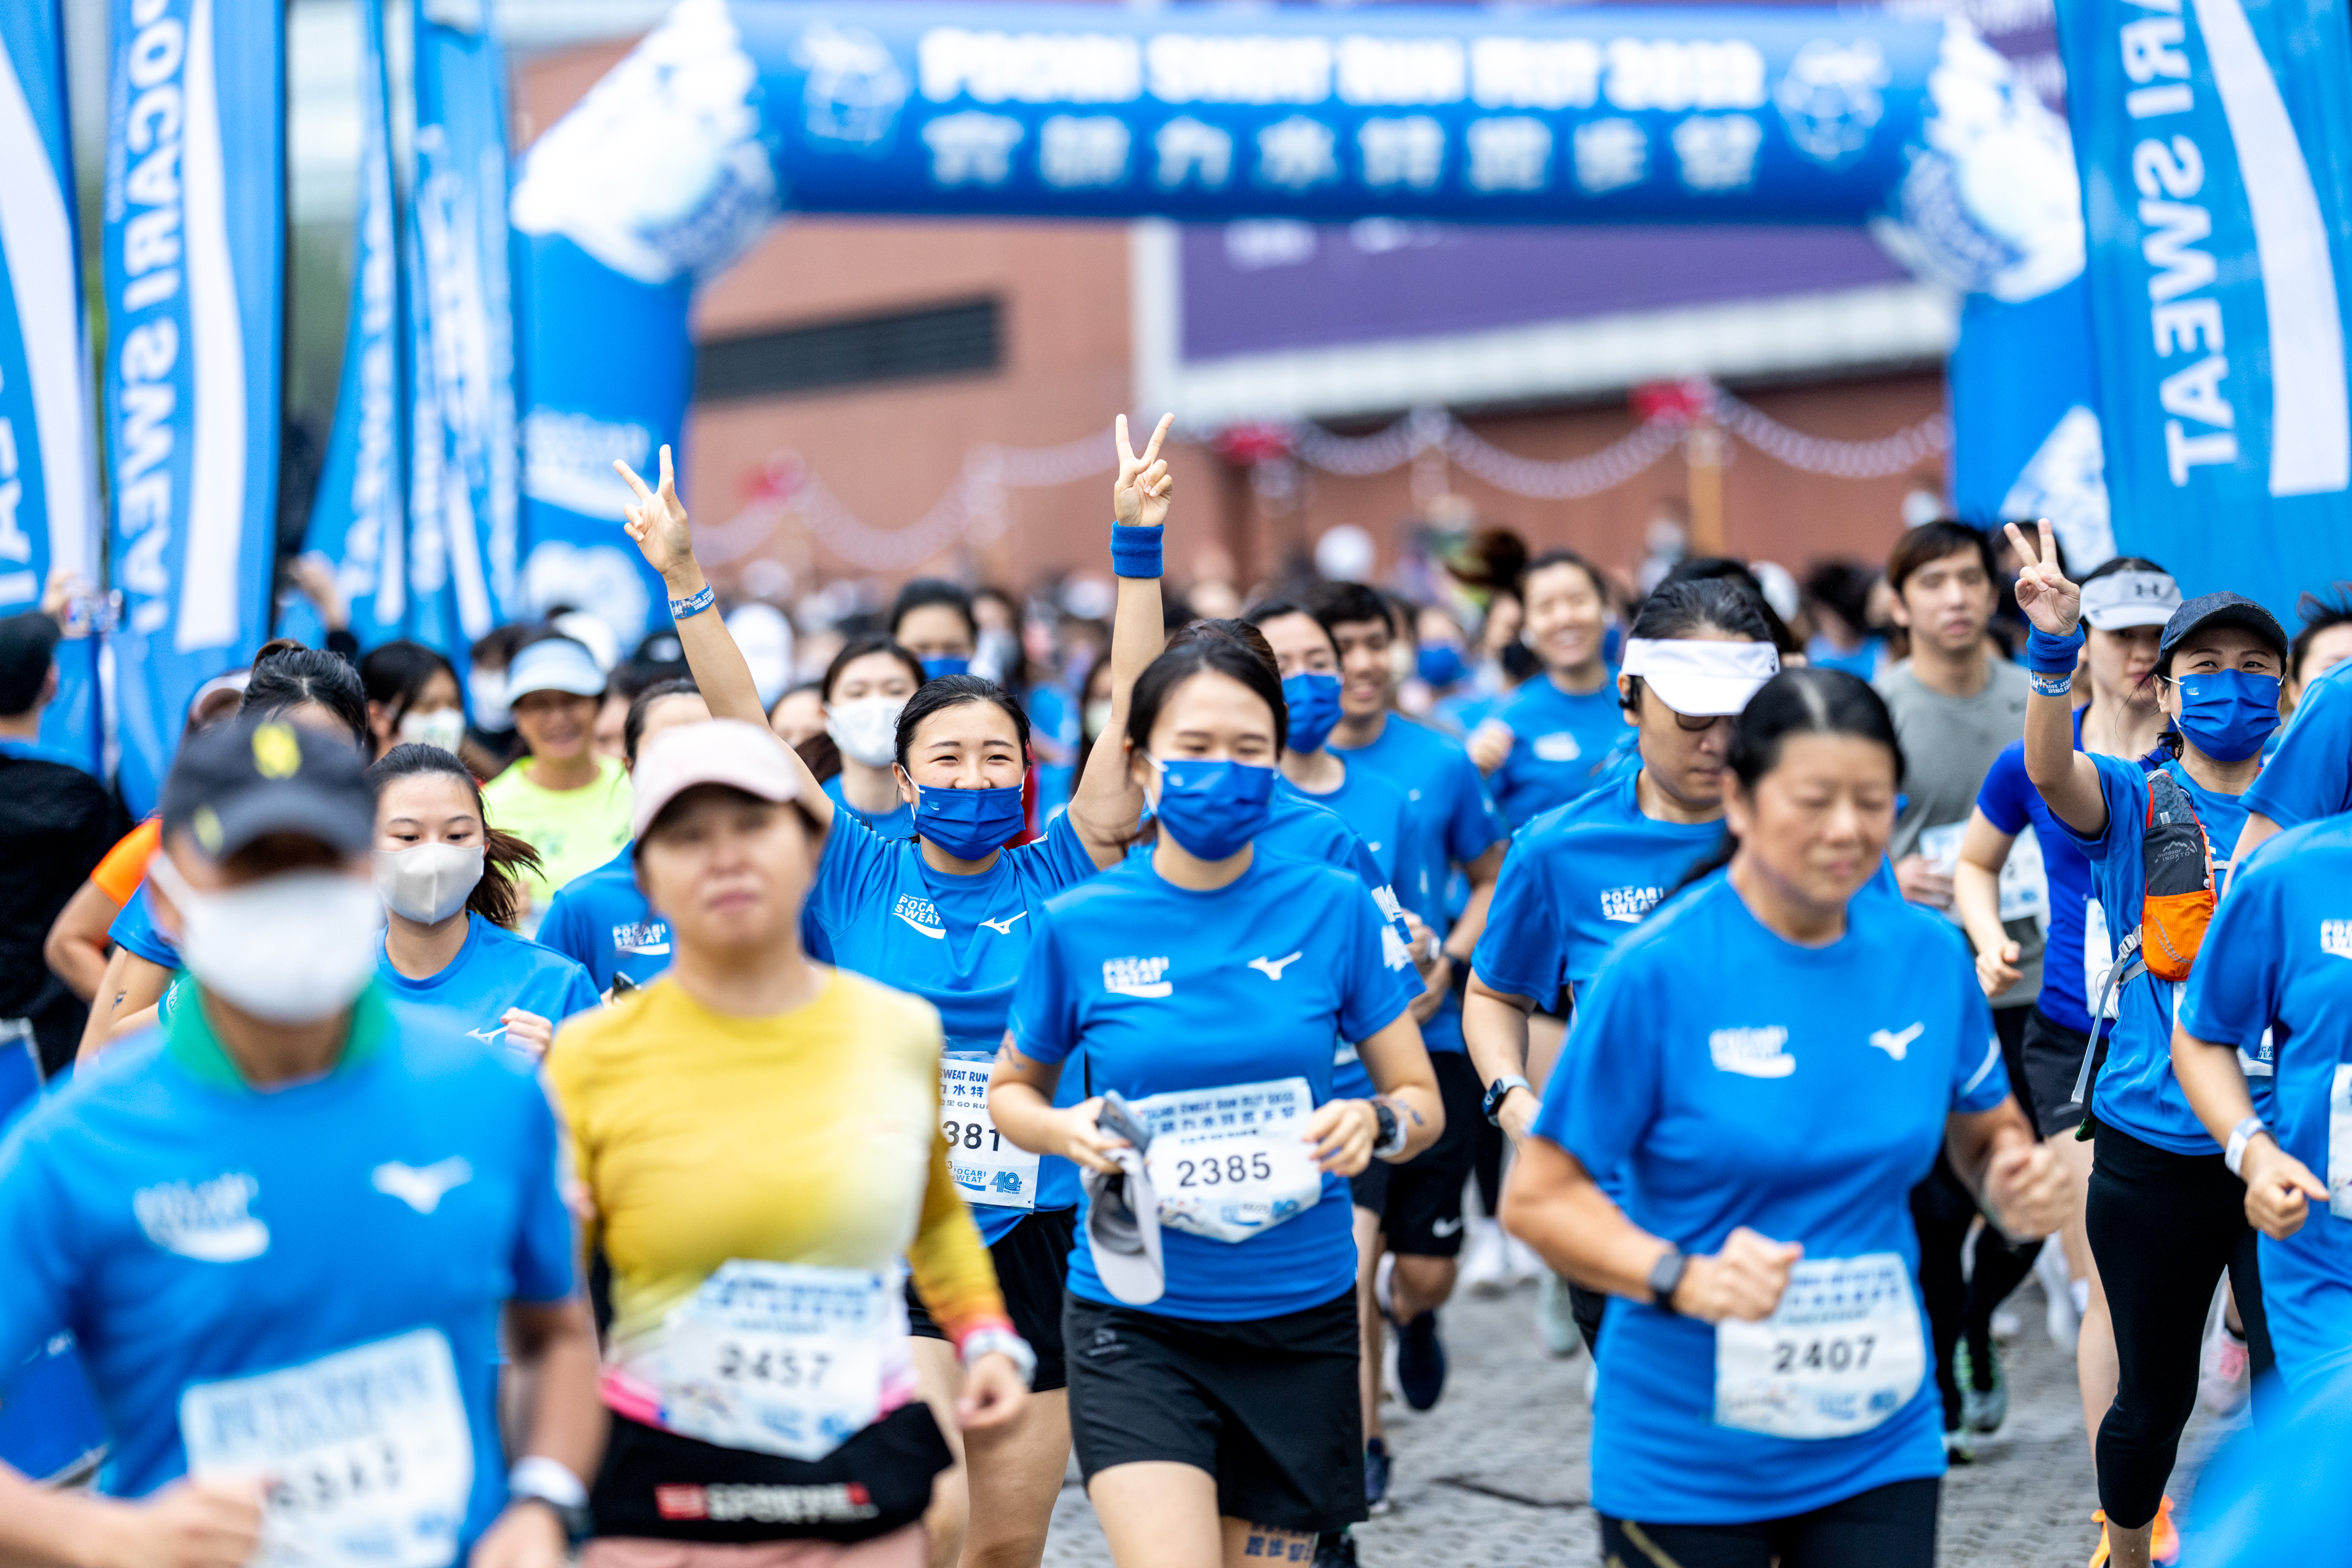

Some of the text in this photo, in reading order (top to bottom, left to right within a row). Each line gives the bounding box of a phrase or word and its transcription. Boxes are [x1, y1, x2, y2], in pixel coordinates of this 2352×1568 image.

[2157, 849, 2182, 858] outdoor
[2163, 851, 2190, 862] INOXTO
[1600, 887, 1664, 906] POCARI
[894, 904, 941, 925] SWEAT
[612, 923, 666, 938] POCARI
[969, 1071, 989, 1083] RUN
[1177, 1152, 1271, 1188] 2385
[1772, 1335, 1875, 1375] 2407
[719, 1341, 831, 1396] 2457
